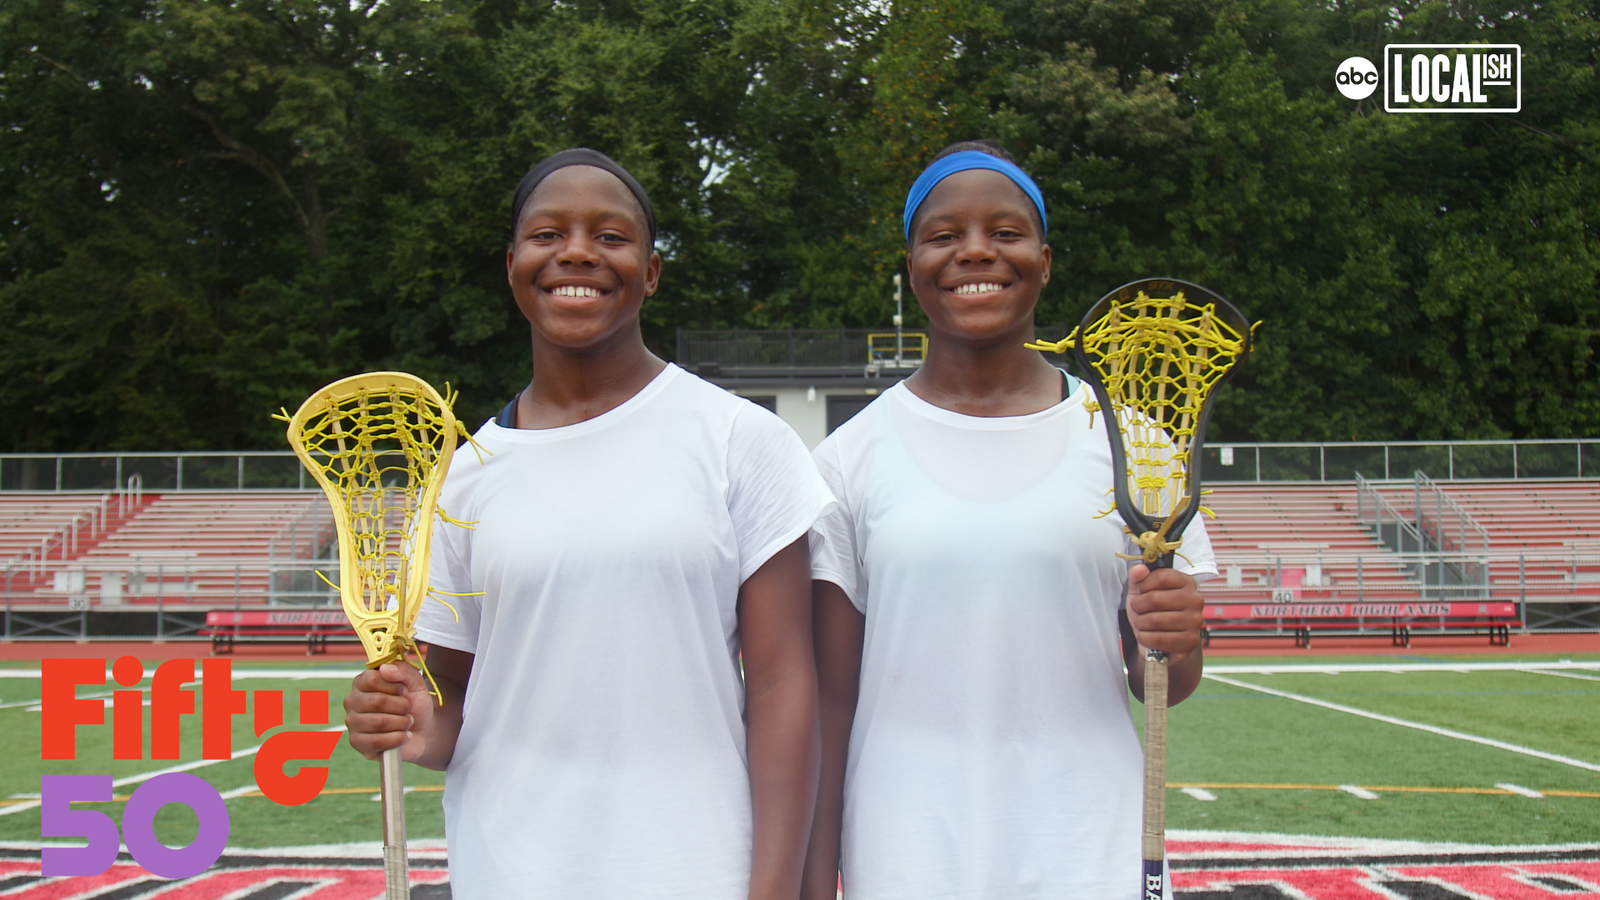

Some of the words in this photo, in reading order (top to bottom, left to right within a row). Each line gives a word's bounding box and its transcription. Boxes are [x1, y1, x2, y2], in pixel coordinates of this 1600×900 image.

[1147, 281, 1176, 290] STX
[1275, 593, 1292, 603] 40
[1250, 604, 1346, 617] NORTHERN
[1350, 603, 1451, 616] HIGHLANDS
[267, 612, 347, 624] NORTHER
